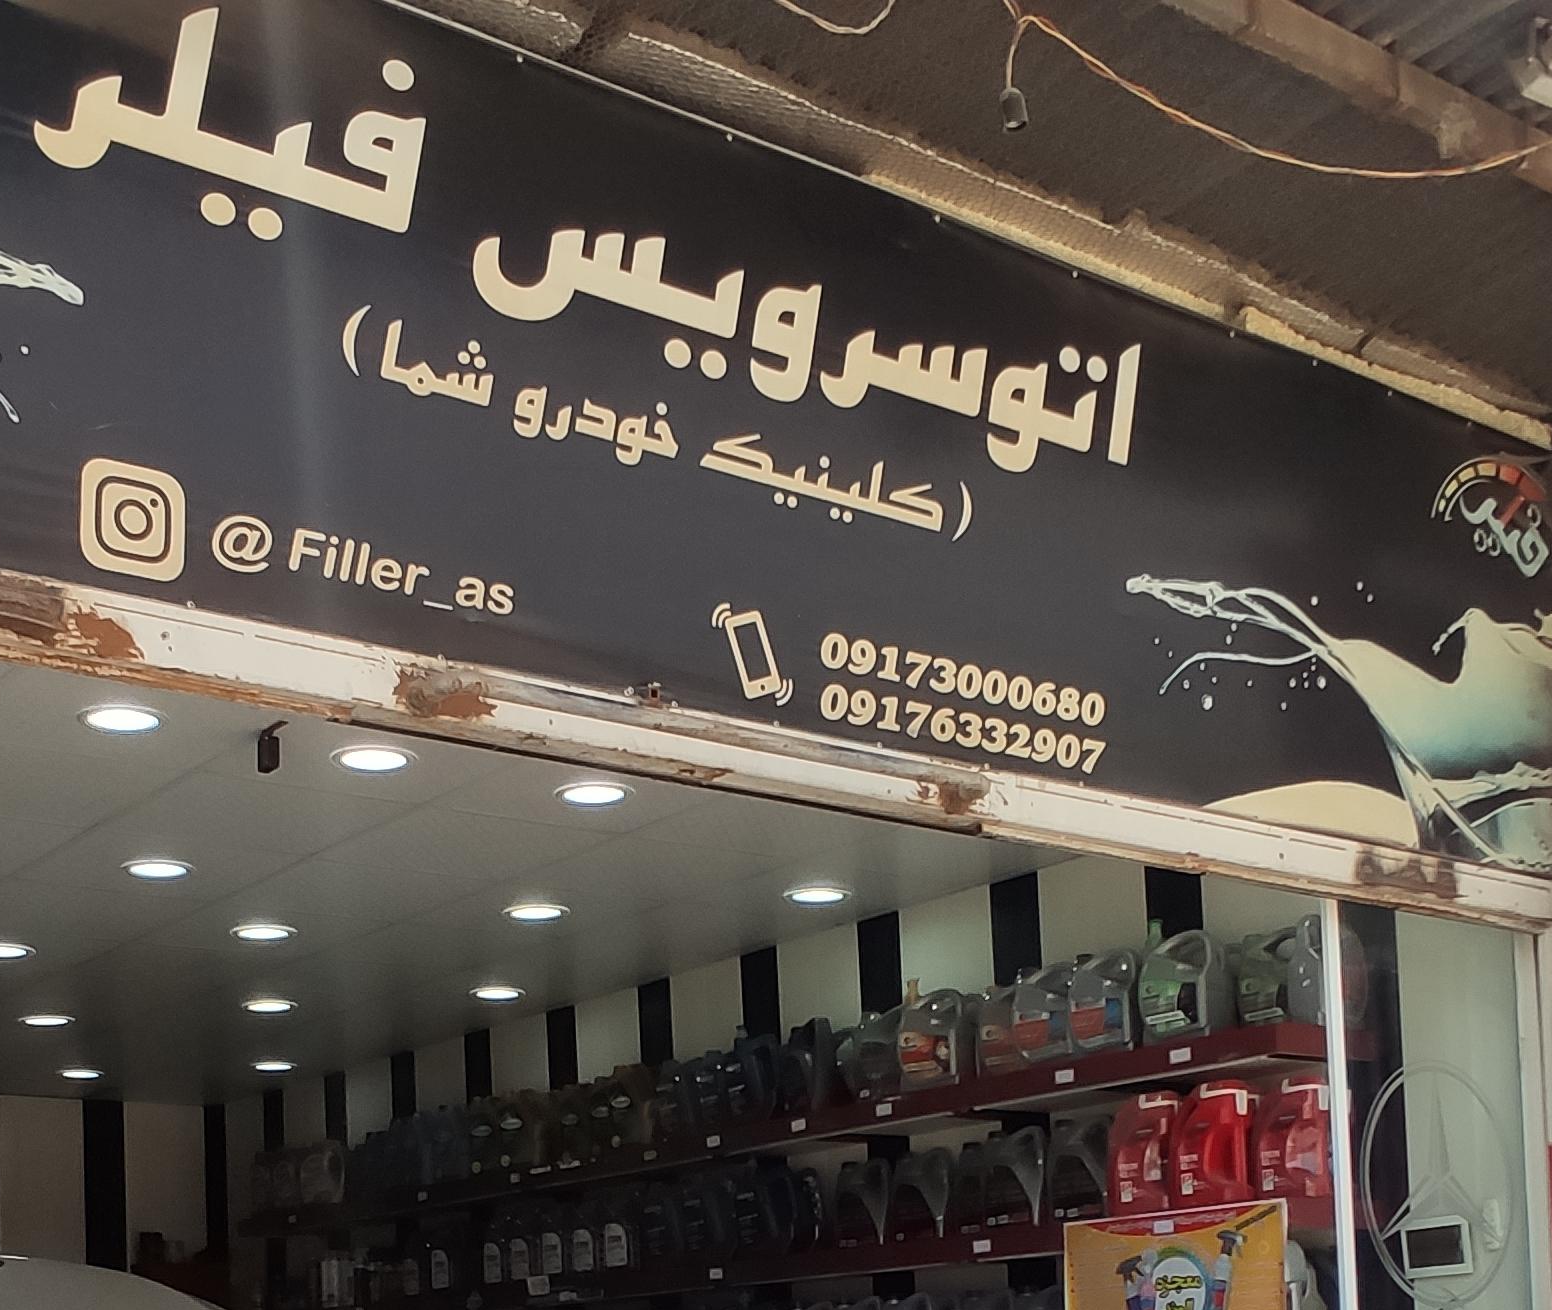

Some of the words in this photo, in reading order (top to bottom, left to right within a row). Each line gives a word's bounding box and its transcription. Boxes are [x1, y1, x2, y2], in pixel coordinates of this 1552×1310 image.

[34, 8, 426, 240] فیلر
[470, 227, 1142, 474] اتوسرویس
[512, 386, 680, 466] خودرو
[212, 515, 273, 573] @
[288, 526, 515, 615] Filler_as
[820, 632, 1107, 727] 09173000680
[820, 684, 1107, 775] 09176332907
